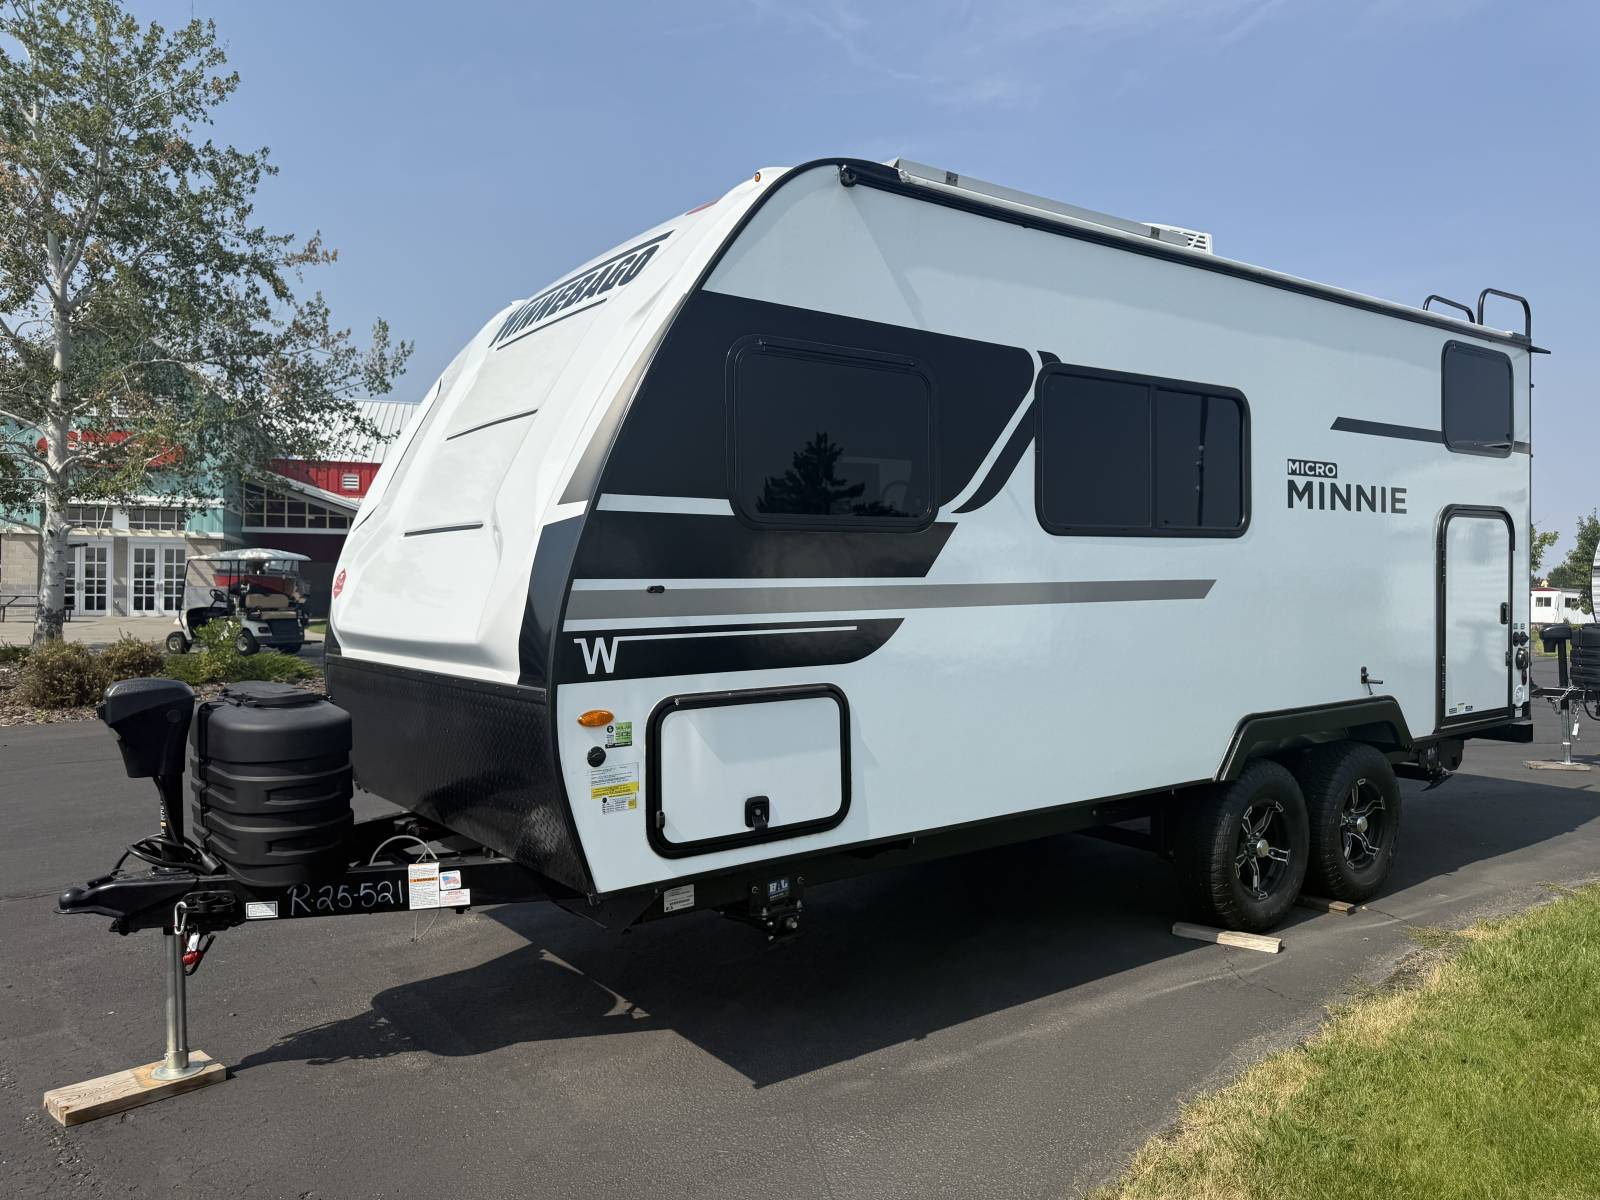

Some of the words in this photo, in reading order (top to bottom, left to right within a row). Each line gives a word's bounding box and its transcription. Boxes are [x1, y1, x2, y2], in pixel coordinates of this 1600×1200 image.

[488, 244, 660, 348] WINNEBAGO
[1288, 460, 1336, 477] MICRO
[1287, 479, 1407, 514] MINNIE
[573, 636, 620, 675] W
